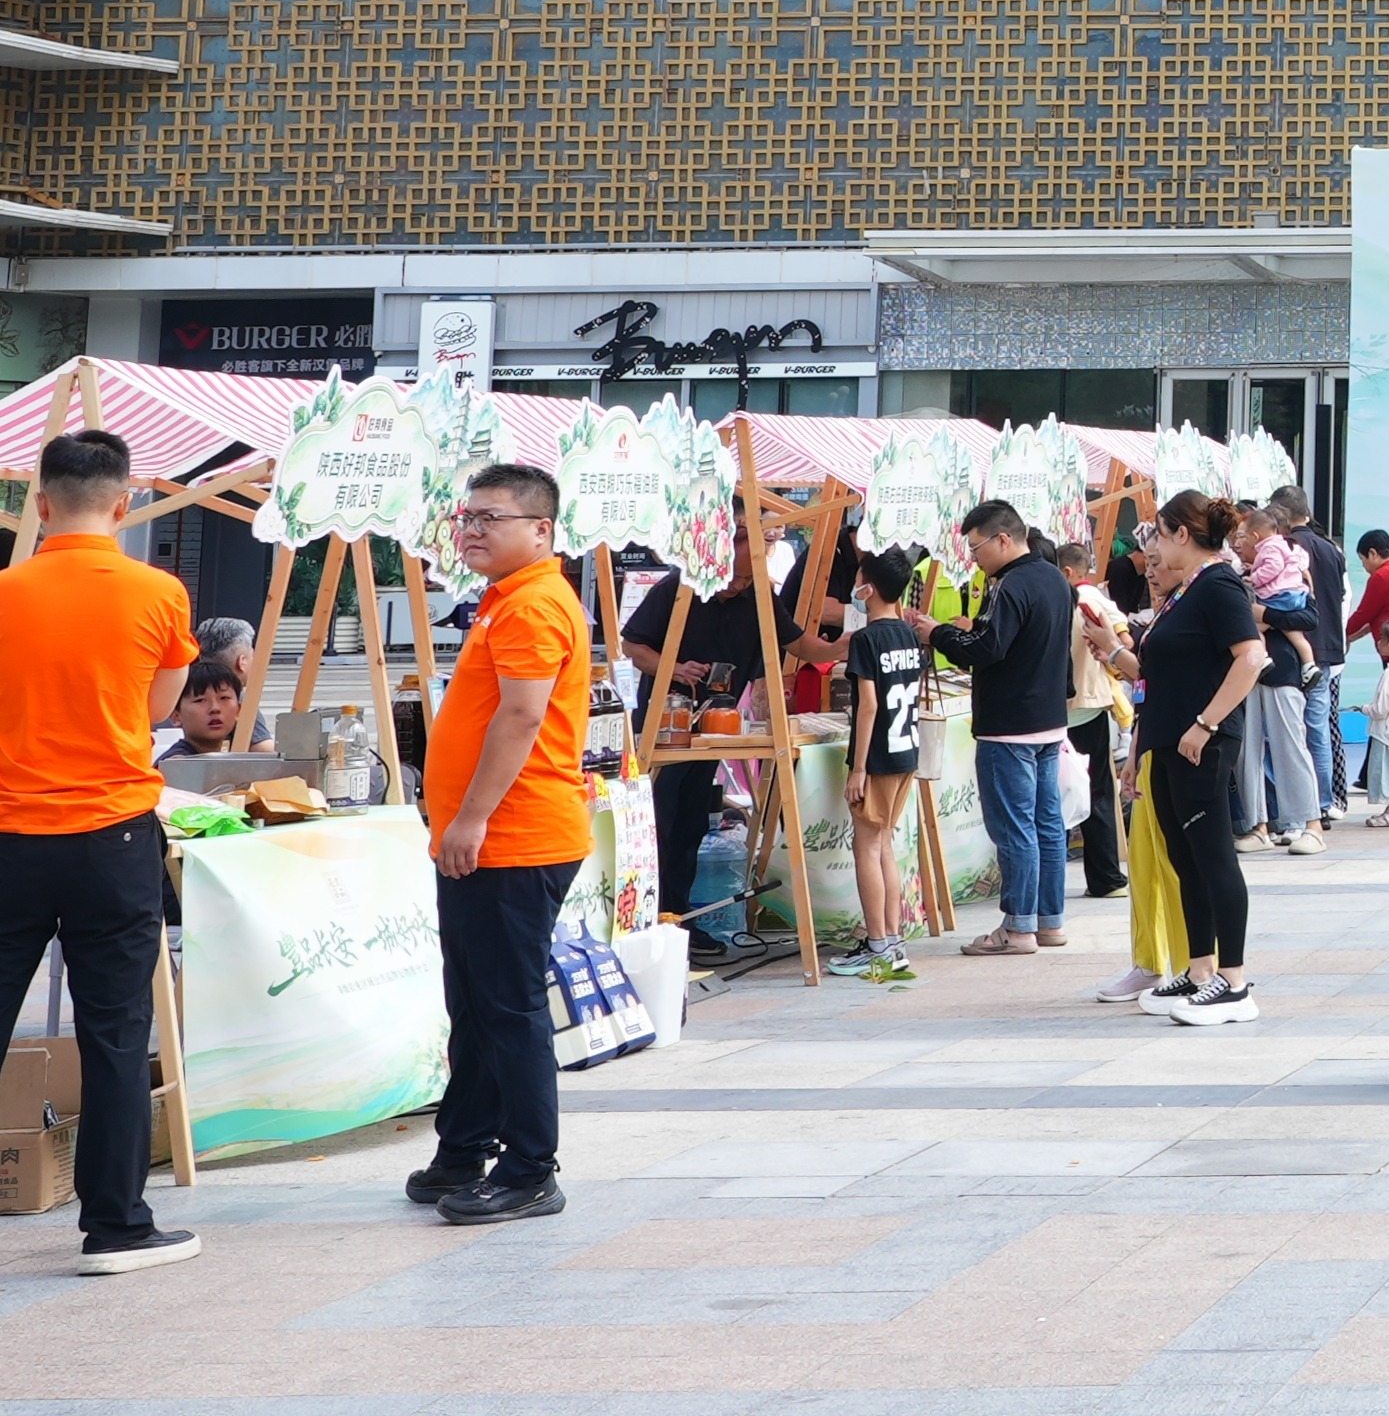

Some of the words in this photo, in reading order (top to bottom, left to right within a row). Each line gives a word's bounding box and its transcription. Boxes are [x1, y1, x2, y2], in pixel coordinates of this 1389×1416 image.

[210, 325, 329, 350] BURGER
[783, 365, 836, 374] V-BURGER
[316, 452, 412, 479] 陕西好邦食品股份
[334, 484, 384, 509] 有限公司
[601, 500, 637, 522] 有限公司
